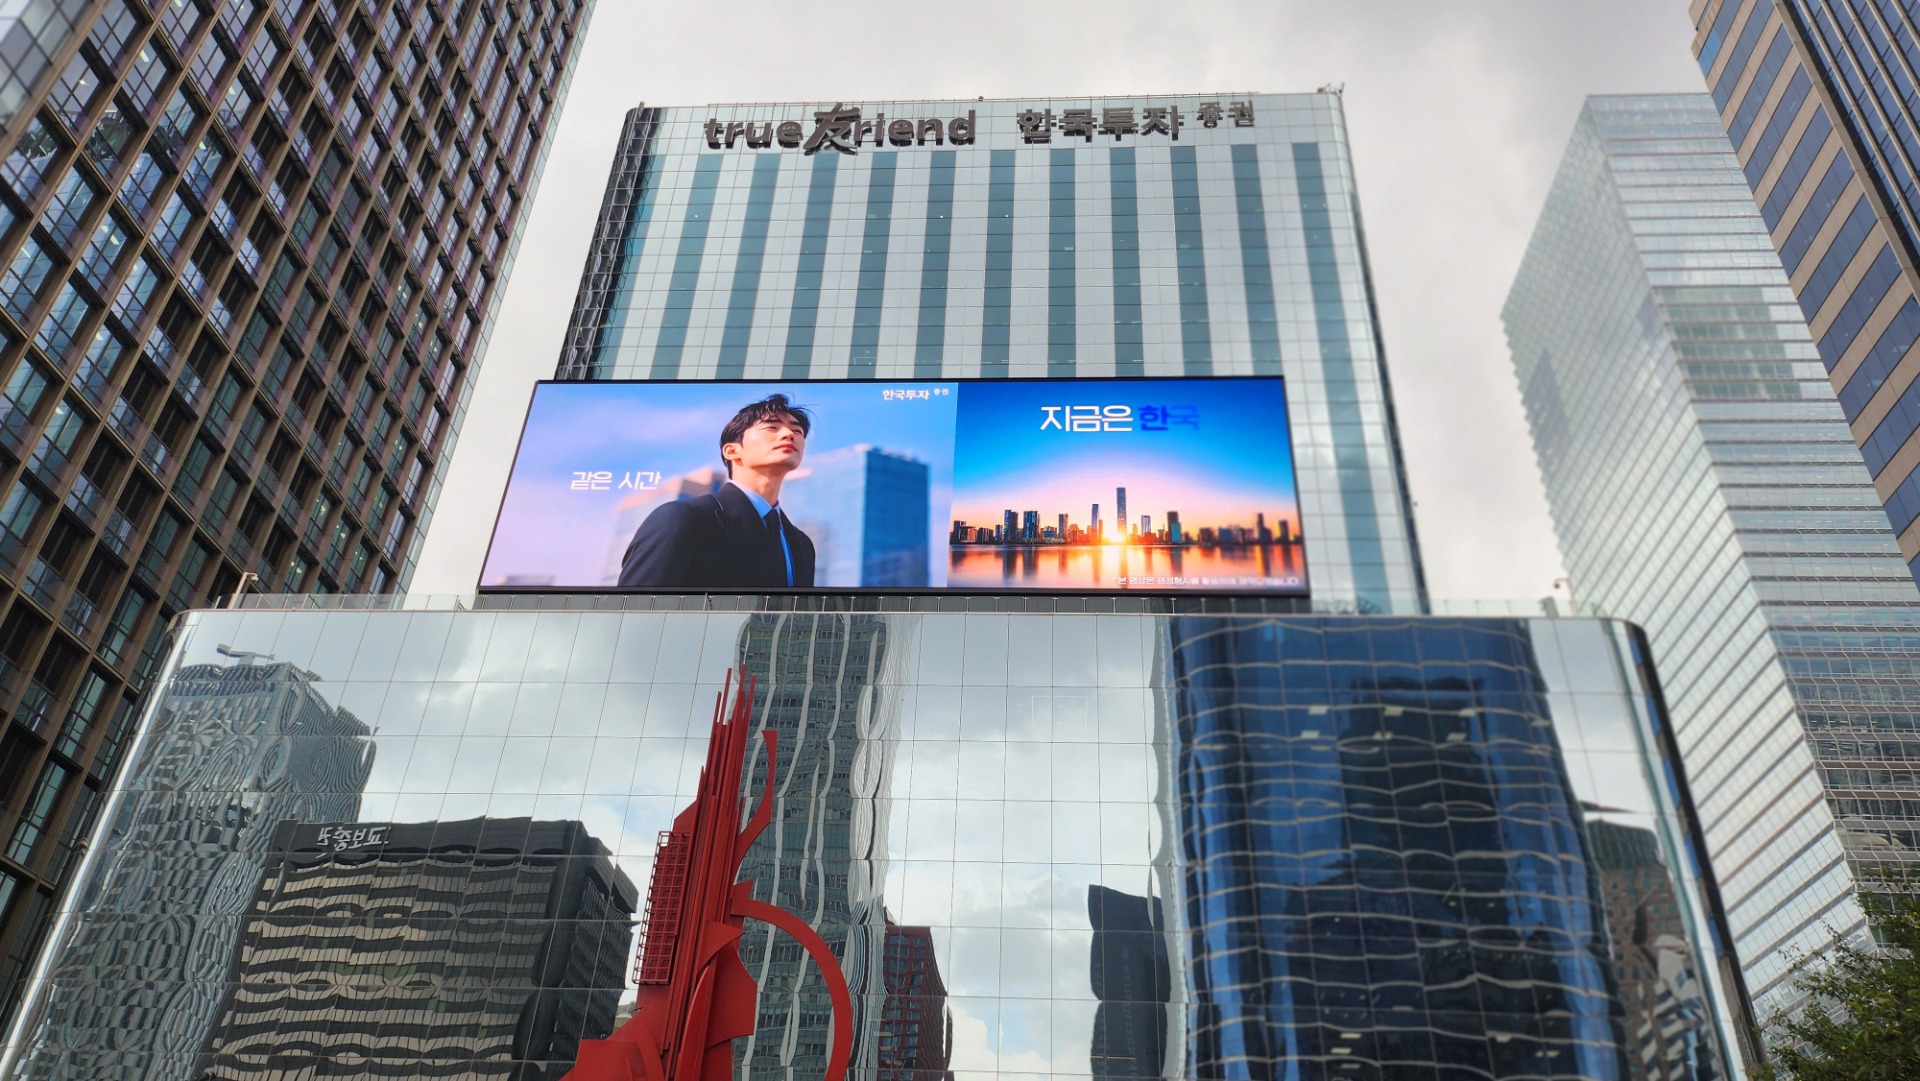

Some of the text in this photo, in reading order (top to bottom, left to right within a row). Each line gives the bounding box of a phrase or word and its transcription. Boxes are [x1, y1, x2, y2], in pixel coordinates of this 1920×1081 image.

[1016, 101, 1255, 140] 한국투자 증권
[882, 388, 949, 400] 한국투자 증권
[1040, 404, 1200, 432] 지금은 한국
[570, 471, 662, 490] 같은 시간
